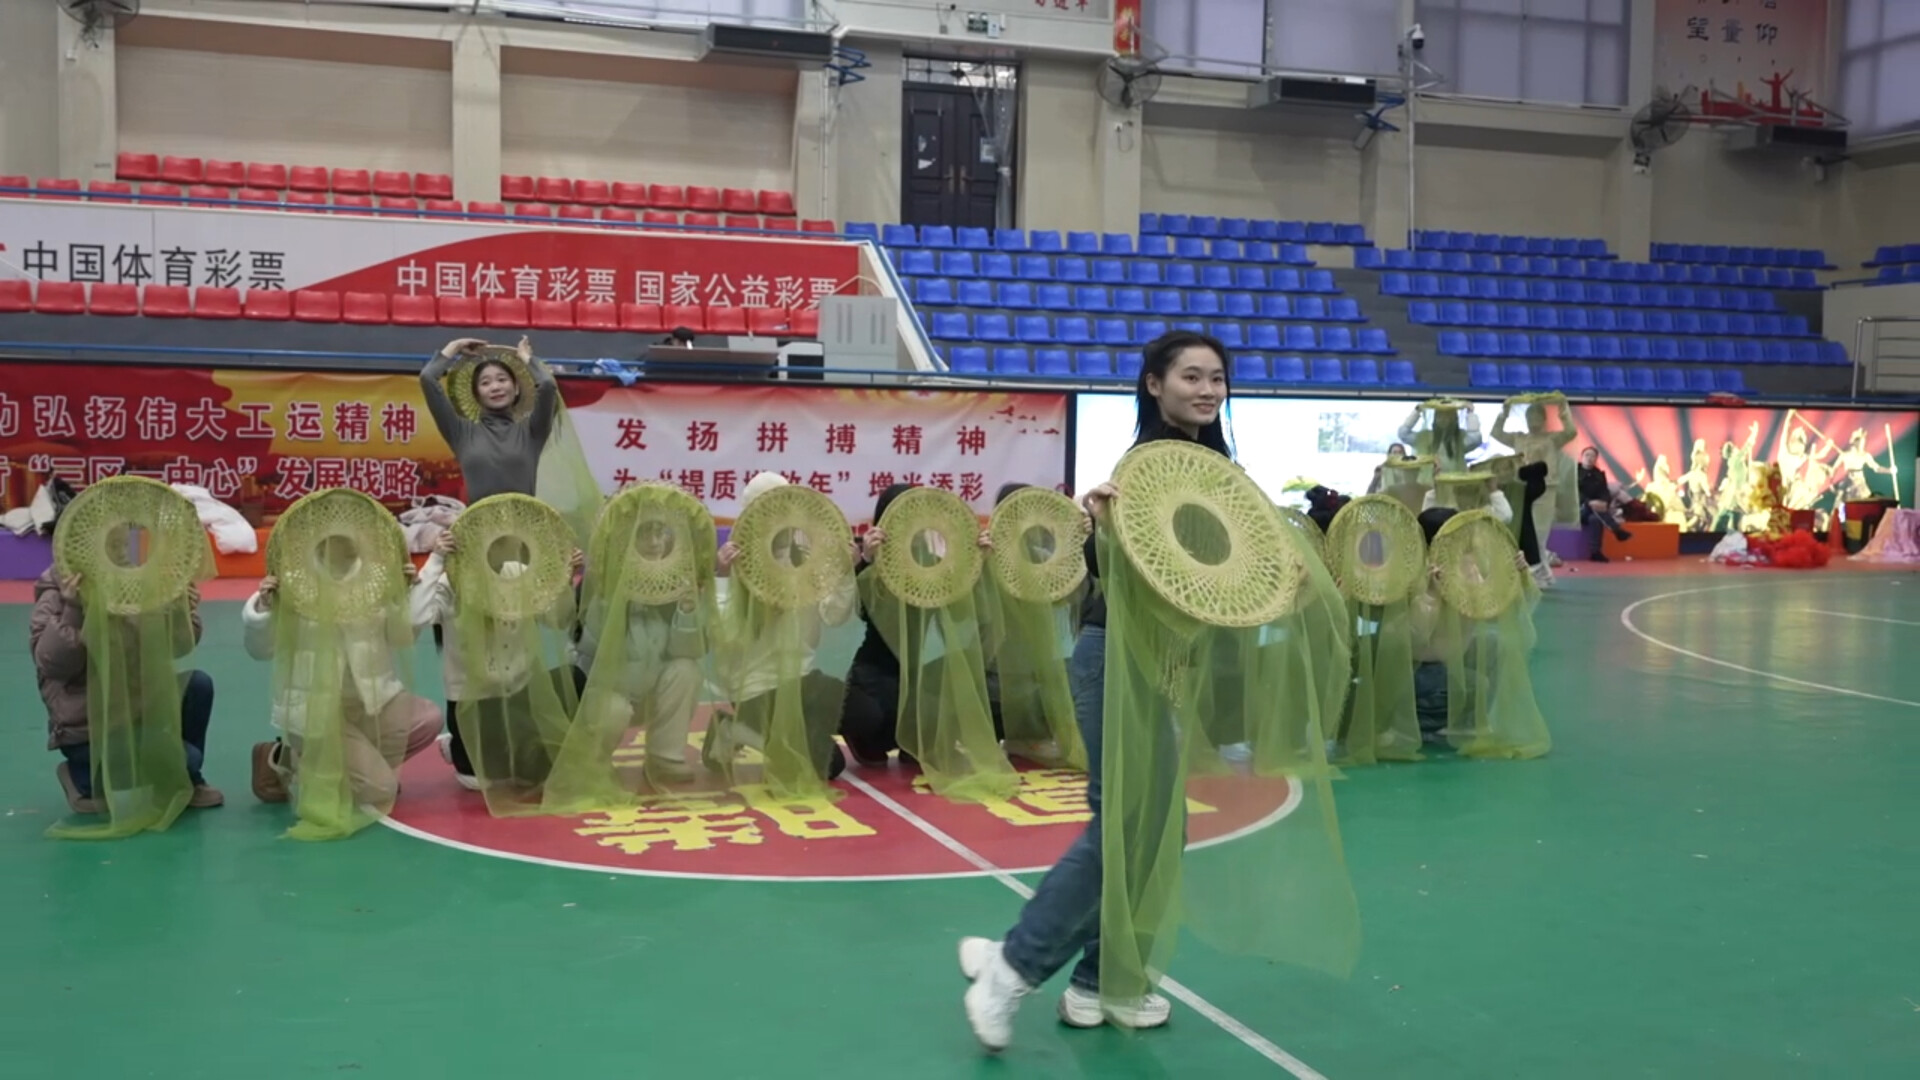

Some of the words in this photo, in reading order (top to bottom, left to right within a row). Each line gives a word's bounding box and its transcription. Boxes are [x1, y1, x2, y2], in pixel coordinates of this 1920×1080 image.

[23, 240, 287, 292] 中国体育彩票
[396, 259, 617, 305] 中国体育彩票
[635, 269, 839, 312] 国家公益彩票
[614, 417, 988, 457] 发扬拼搏精神
